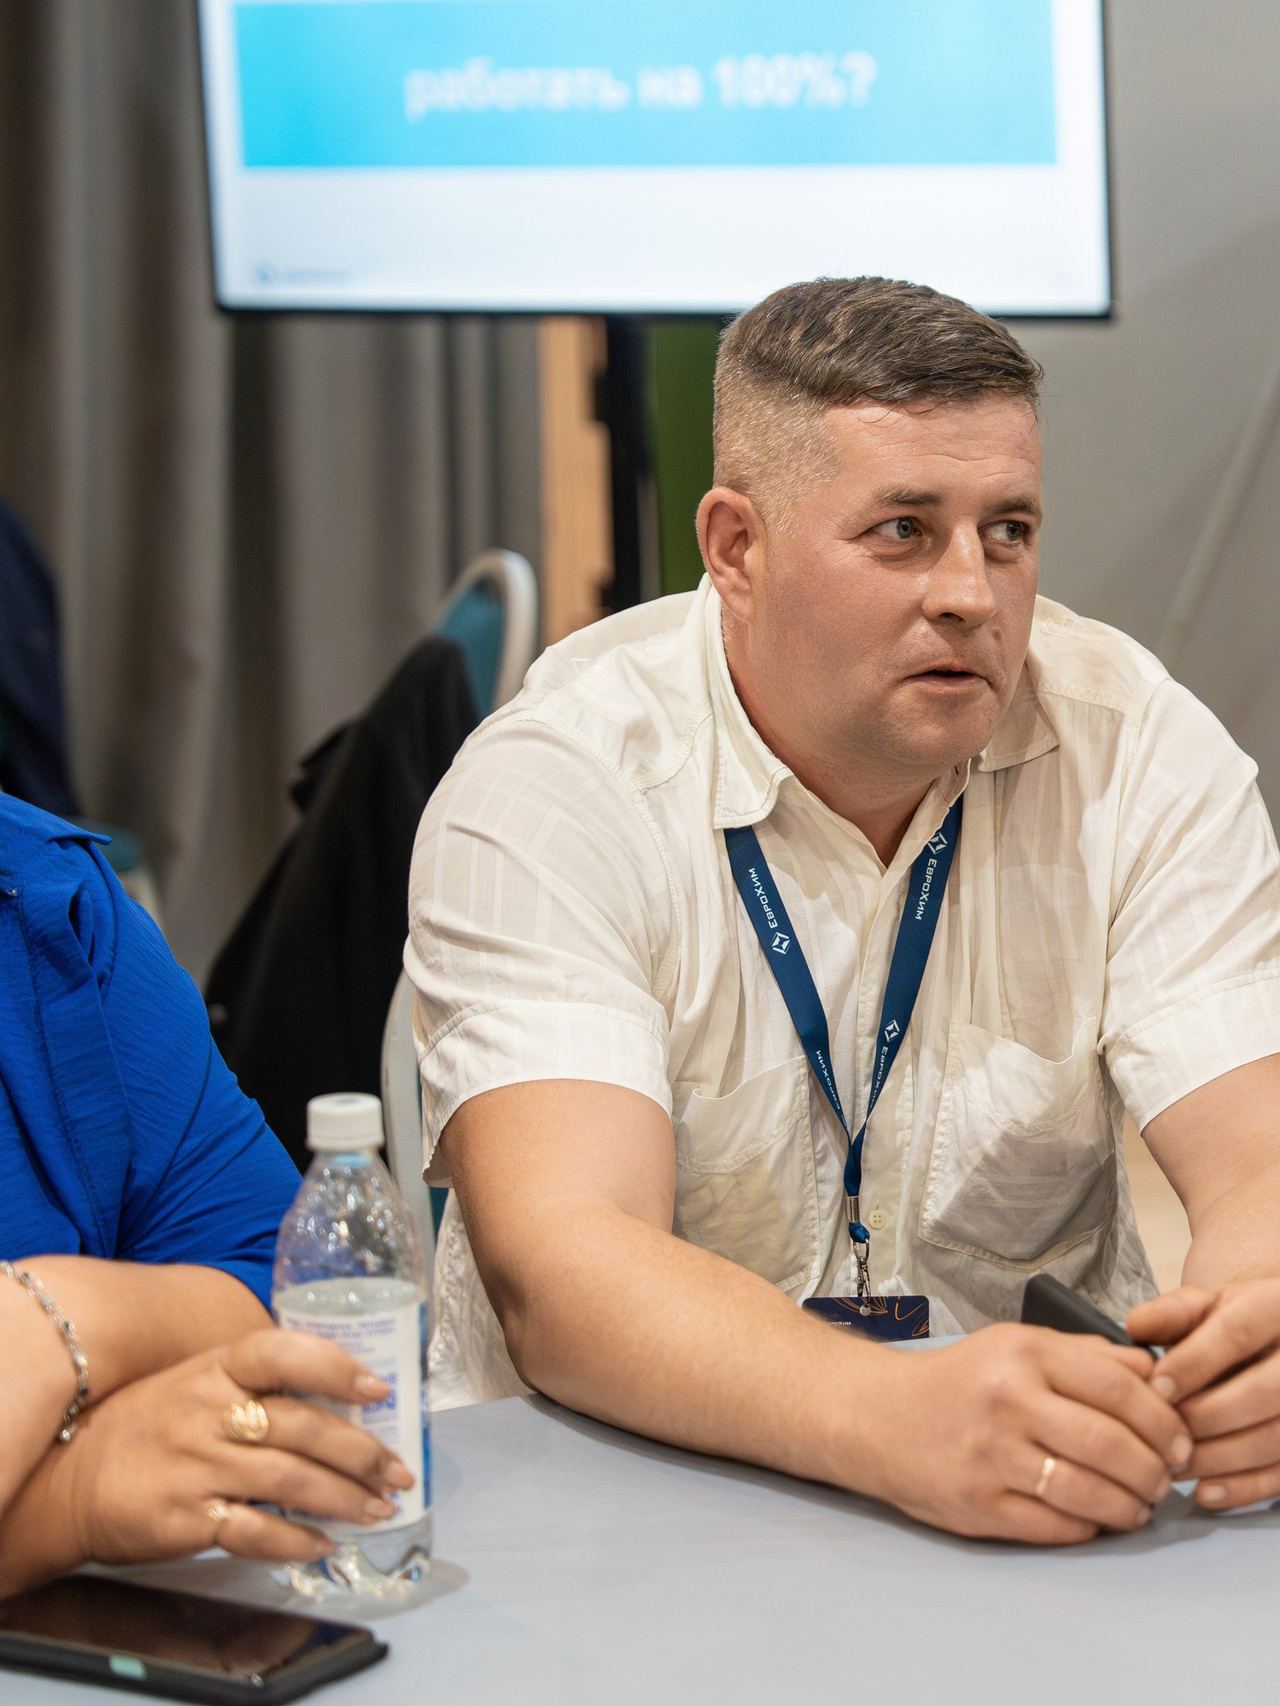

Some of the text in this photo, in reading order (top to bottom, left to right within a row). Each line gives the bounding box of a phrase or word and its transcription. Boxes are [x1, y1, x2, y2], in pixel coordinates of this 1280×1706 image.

[405, 51, 878, 122] работать на 100%?
